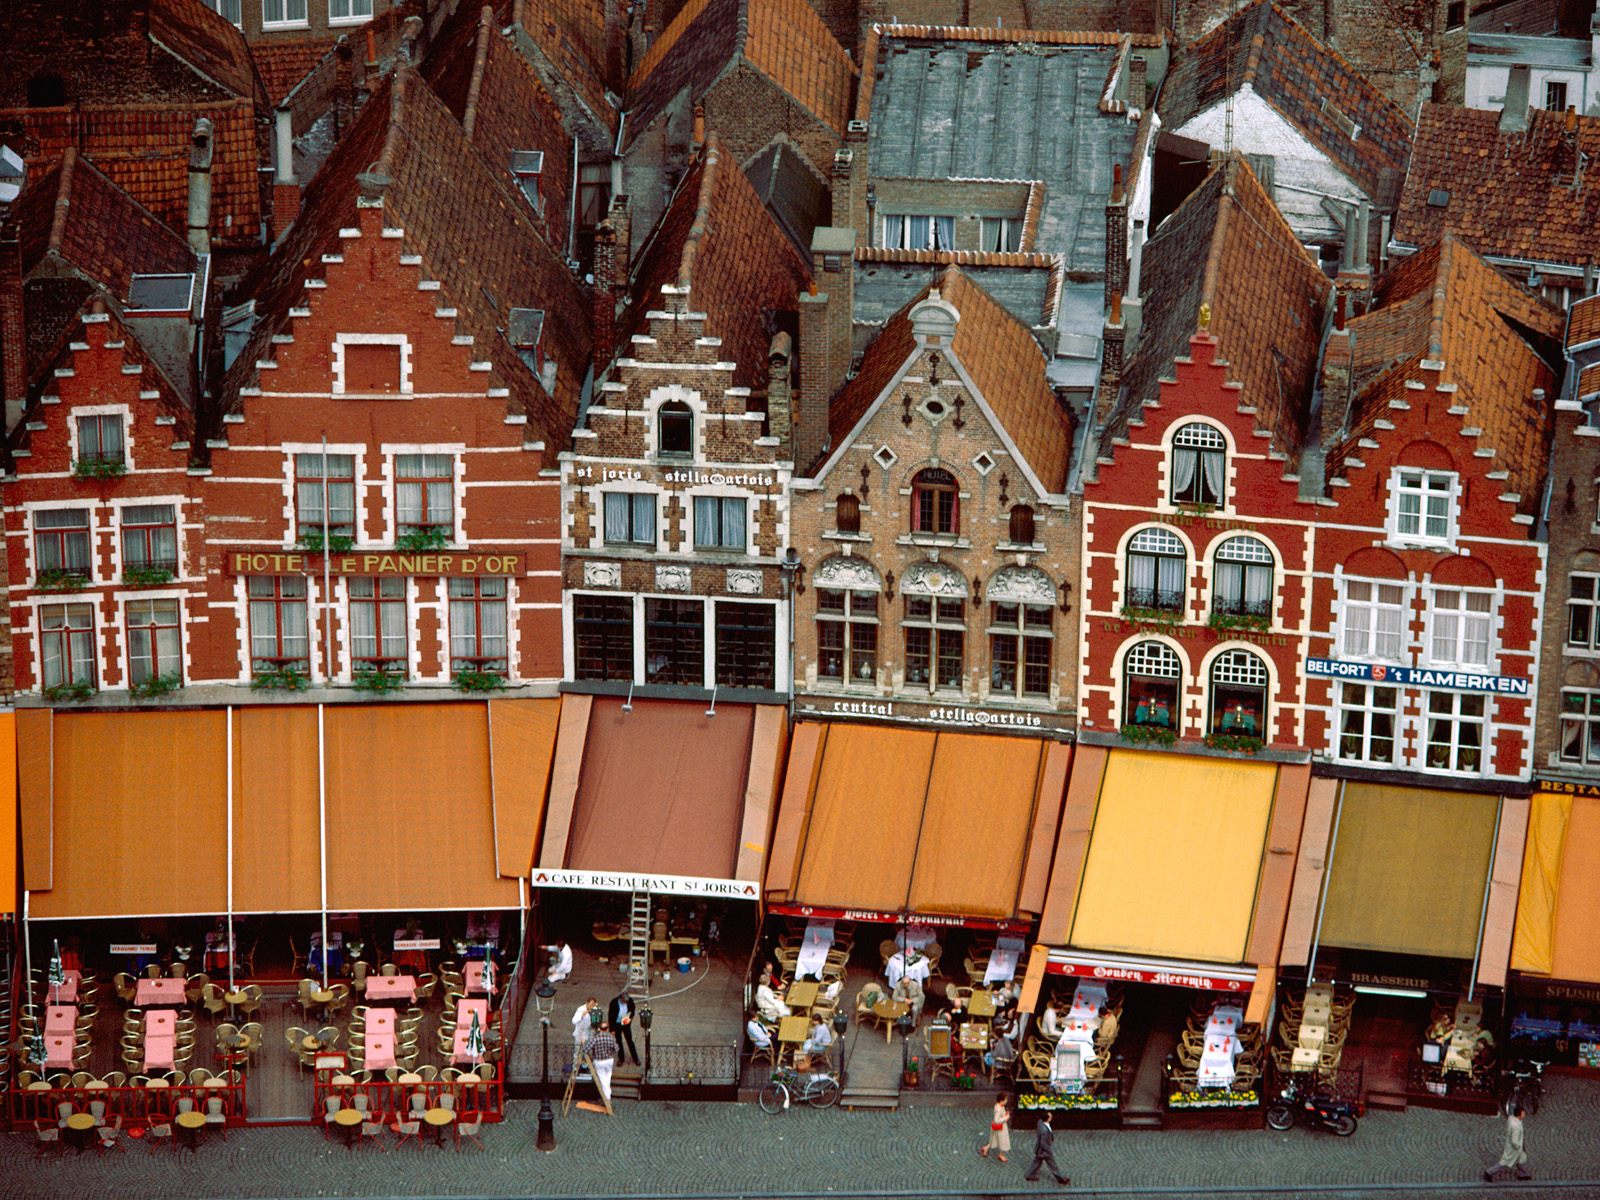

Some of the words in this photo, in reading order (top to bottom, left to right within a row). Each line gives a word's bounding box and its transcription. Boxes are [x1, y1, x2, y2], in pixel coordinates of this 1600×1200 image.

[577, 465, 593, 479] st
[602, 468, 642, 482] joris
[665, 470, 709, 484] stella
[726, 473, 772, 487] artois
[235, 554, 318, 573] HOTEL
[329, 556, 356, 573] LE
[364, 555, 453, 573] PANIER
[461, 555, 519, 574] D'OR
[1307, 660, 1368, 677] BELFORT
[1391, 668, 1402, 682] 't
[1409, 670, 1529, 693] HAMERKEN
[834, 701, 893, 715] central
[929, 707, 974, 723] stella
[990, 710, 1042, 727] artois
[1540, 781, 1600, 796] RESTA
[551, 873, 585, 885] CAFE
[592, 876, 677, 890] RESTAURANT
[702, 883, 741, 895] JORIS
[1093, 966, 1144, 982] Gouden
[1351, 972, 1430, 989] BRASSERIE
